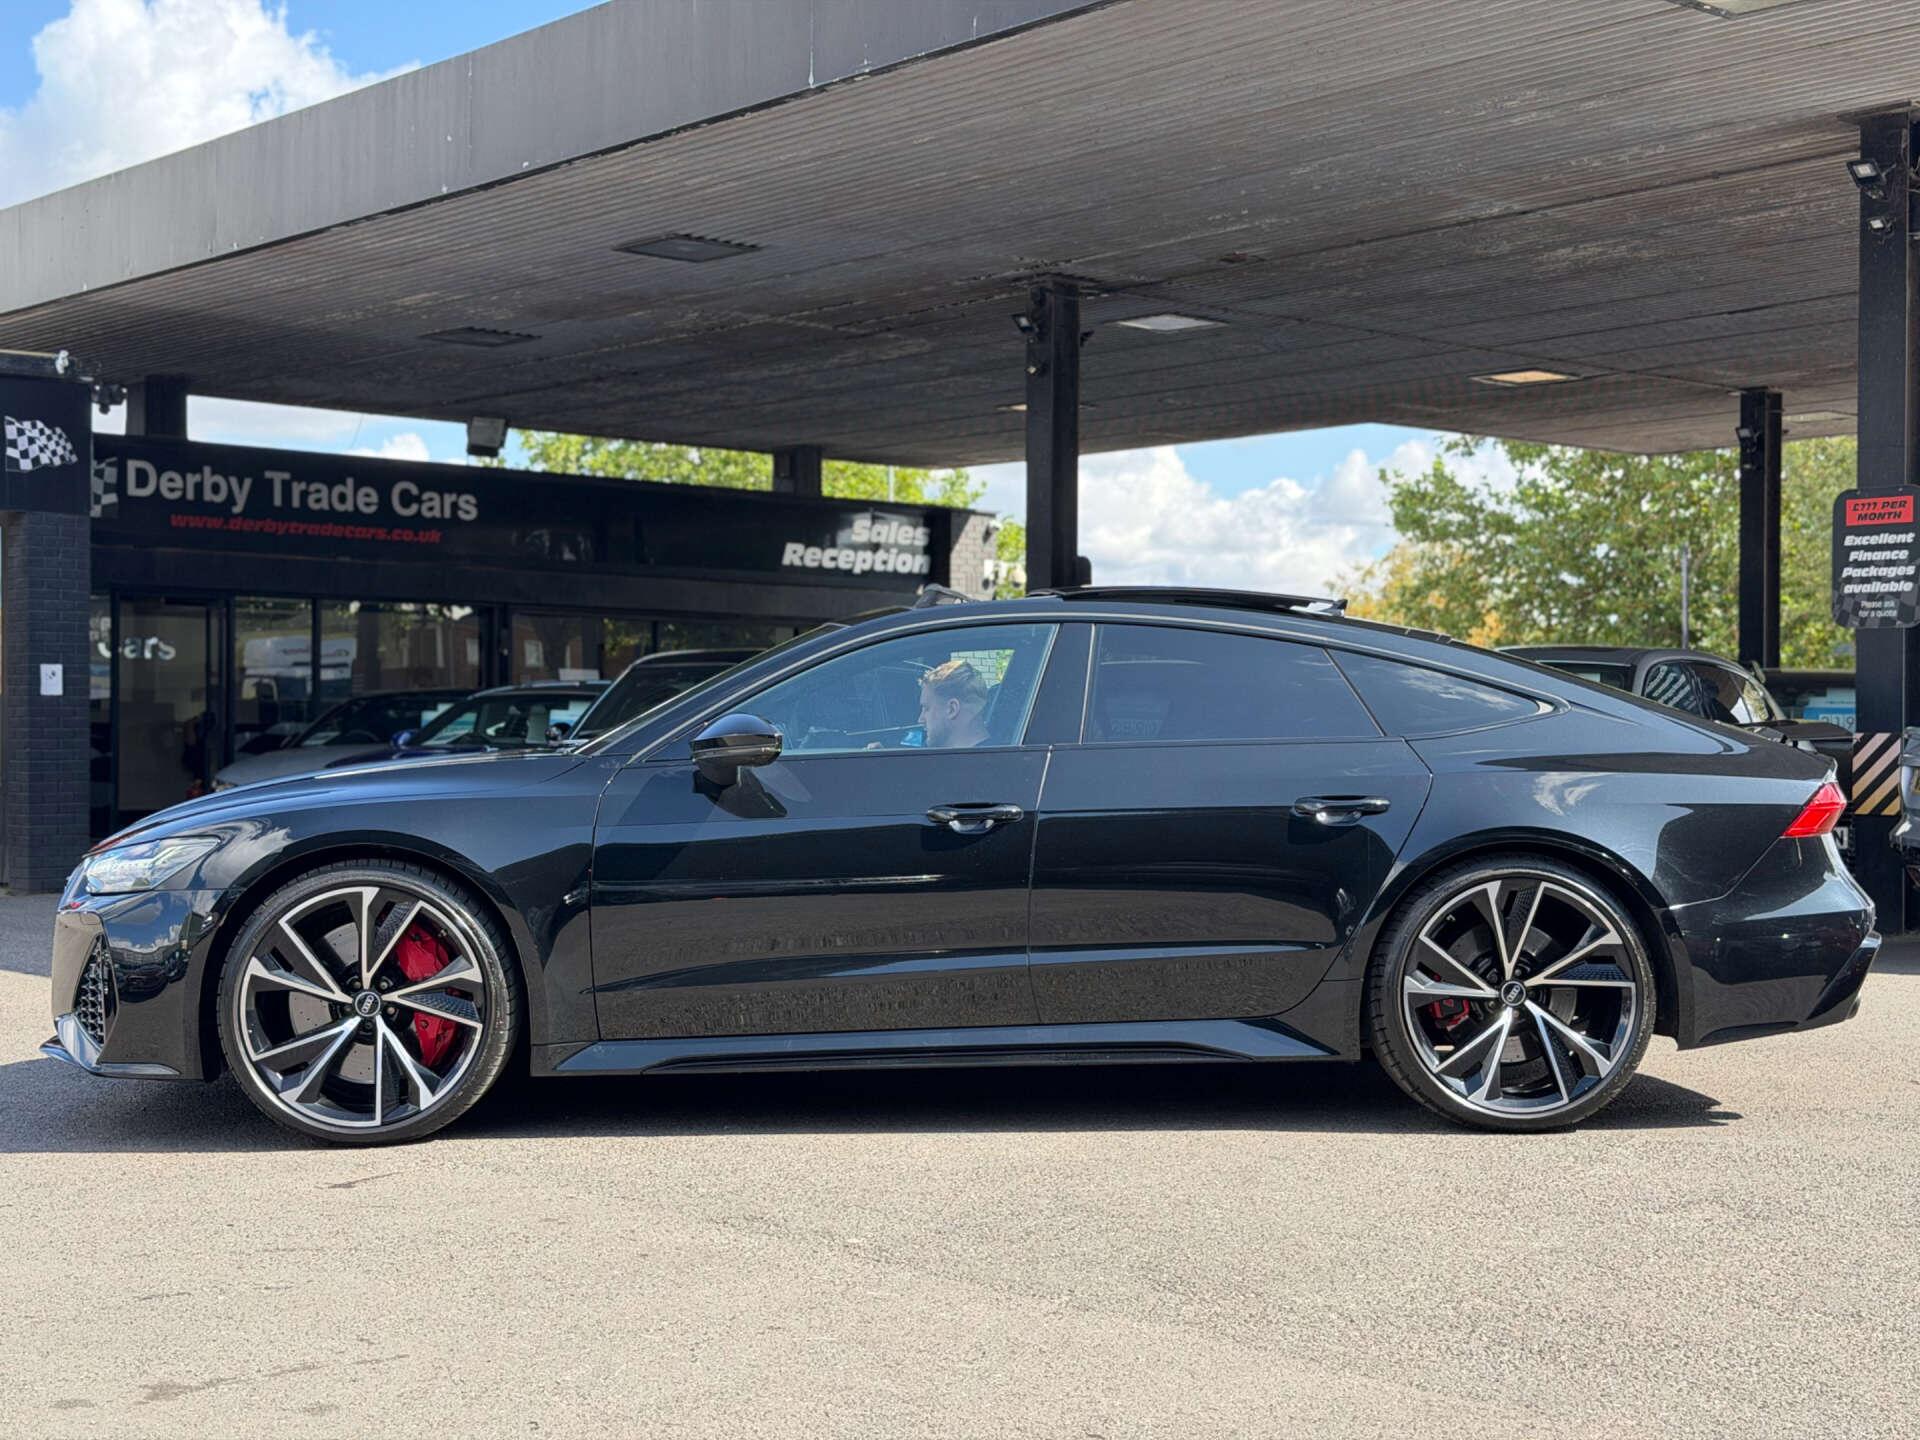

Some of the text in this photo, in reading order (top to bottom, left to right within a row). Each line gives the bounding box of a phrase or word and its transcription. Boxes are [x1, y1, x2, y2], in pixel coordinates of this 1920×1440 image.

[126, 459, 479, 522] Derby Trade Cars
[1881, 500, 1907, 509] PER
[1857, 511, 1902, 521] MONTH
[170, 513, 443, 544] www.derbytradecars.co.uk
[851, 518, 930, 547] Sales
[1843, 532, 1916, 546] Excellent
[781, 541, 931, 575] Reception
[1848, 549, 1909, 562] Finance
[1841, 565, 1916, 578] Packages
[1843, 581, 1914, 594] available
